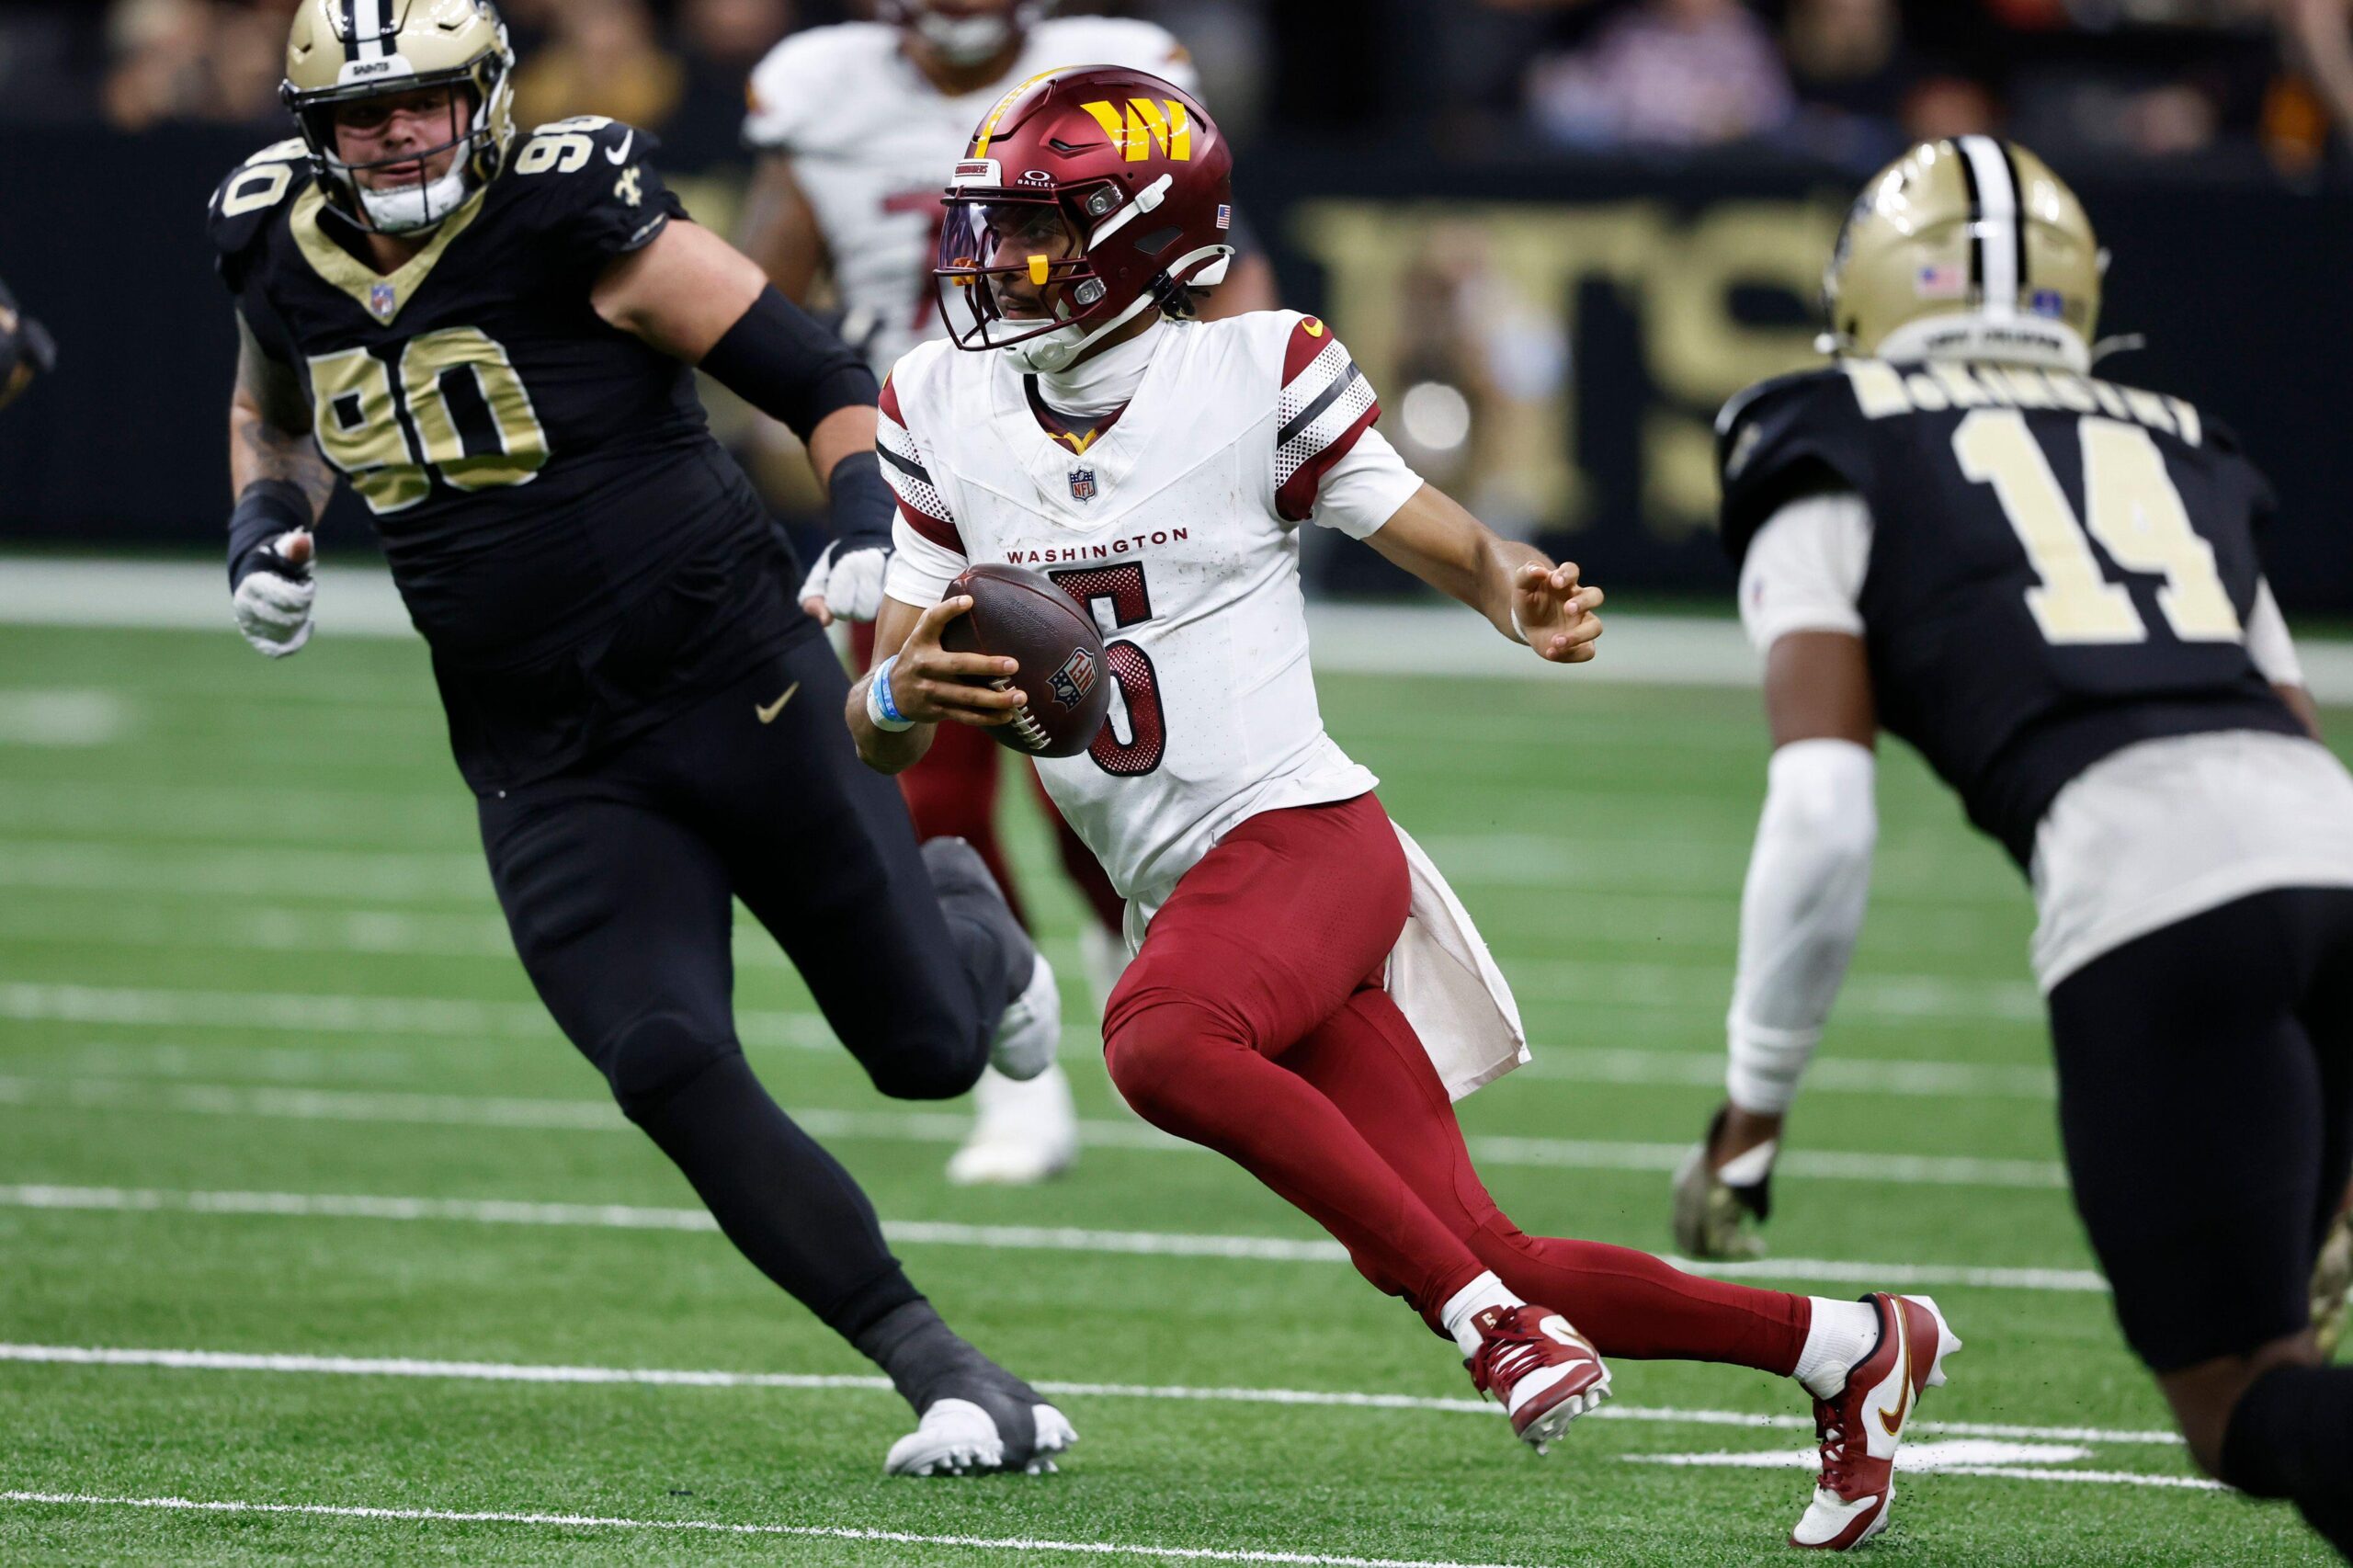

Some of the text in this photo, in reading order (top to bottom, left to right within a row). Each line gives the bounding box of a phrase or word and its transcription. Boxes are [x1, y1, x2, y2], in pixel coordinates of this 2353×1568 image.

[1017, 178, 1056, 188] OAKLEY
[306, 324, 551, 517] 90
[1073, 481, 1095, 497] NFL
[1006, 527, 1189, 564] WASHINGTON
[1950, 407, 2246, 645] 14
[1048, 561, 1167, 778] 5
[1068, 652, 1097, 695] NFL
